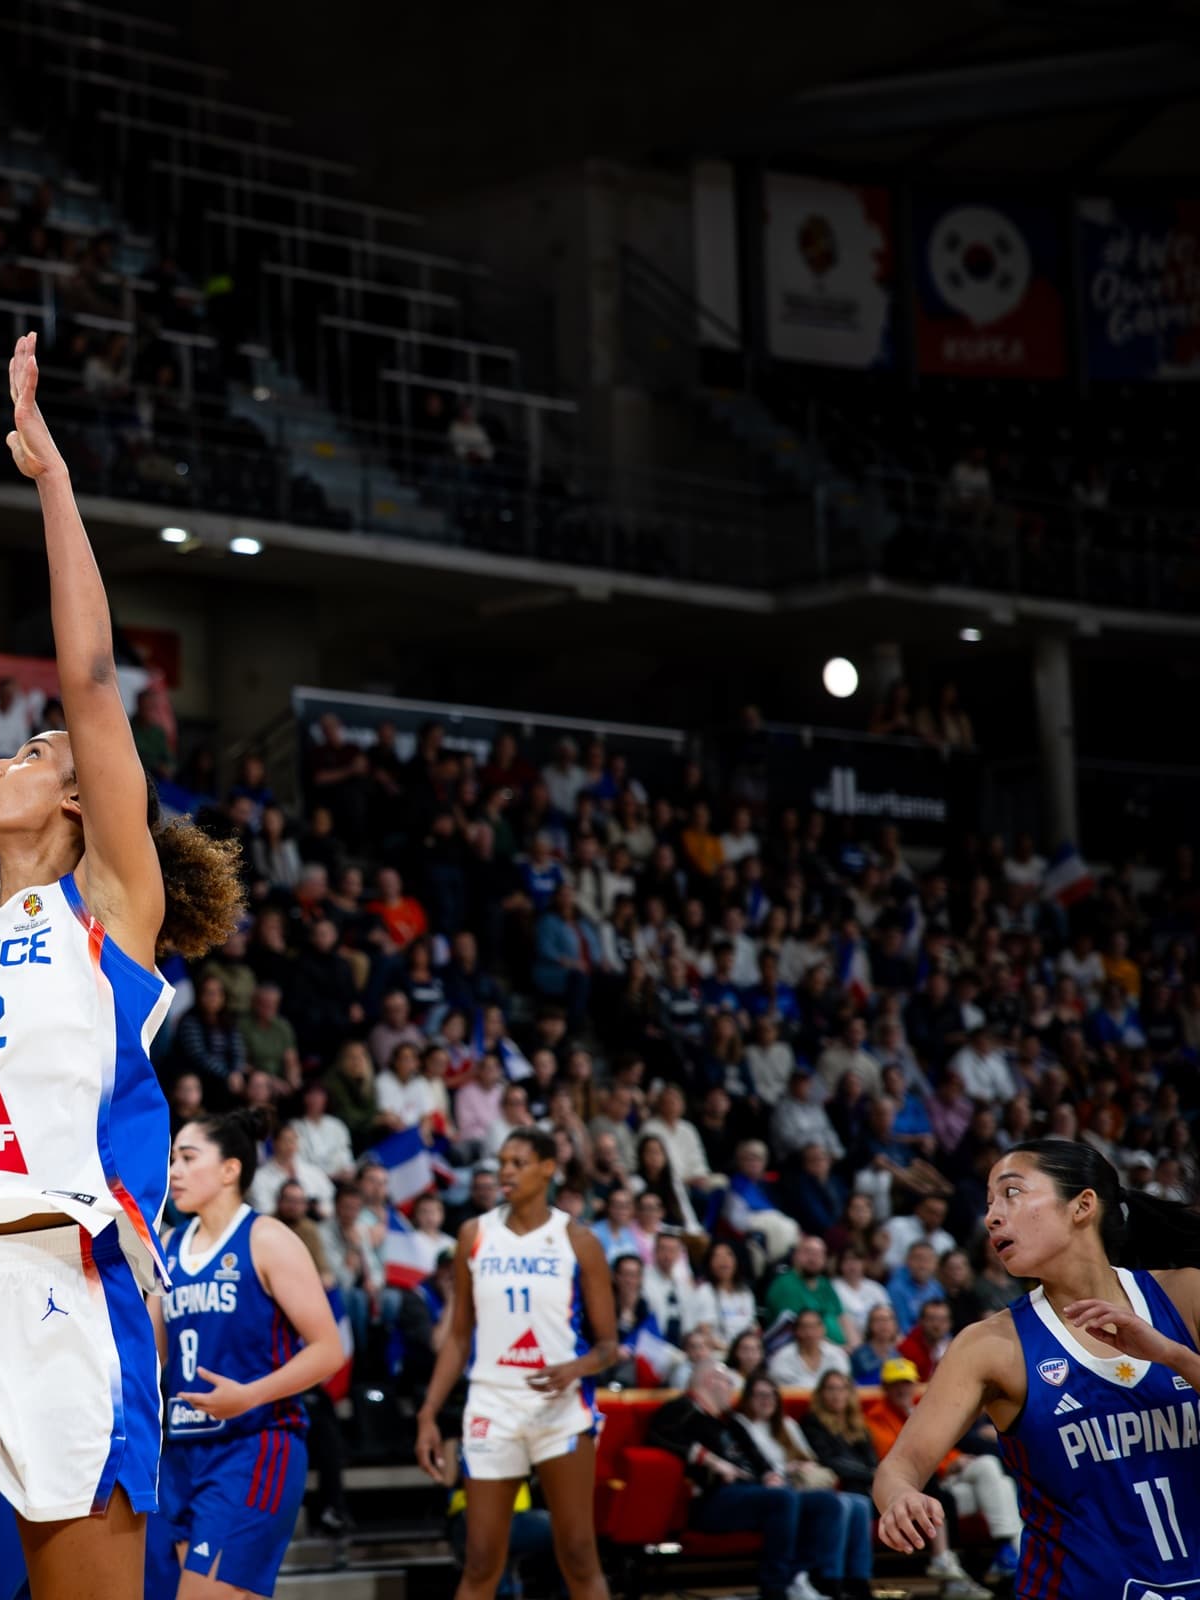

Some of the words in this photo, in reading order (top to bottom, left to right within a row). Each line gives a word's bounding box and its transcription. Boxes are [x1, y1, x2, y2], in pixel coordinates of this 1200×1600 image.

[480, 1256, 561, 1277] FRANCE
[504, 1286, 530, 1313] 11
[179, 1328, 199, 1383] 8
[1057, 1398, 1200, 1470] PILIPINA
[1132, 1476, 1189, 1562] 11
